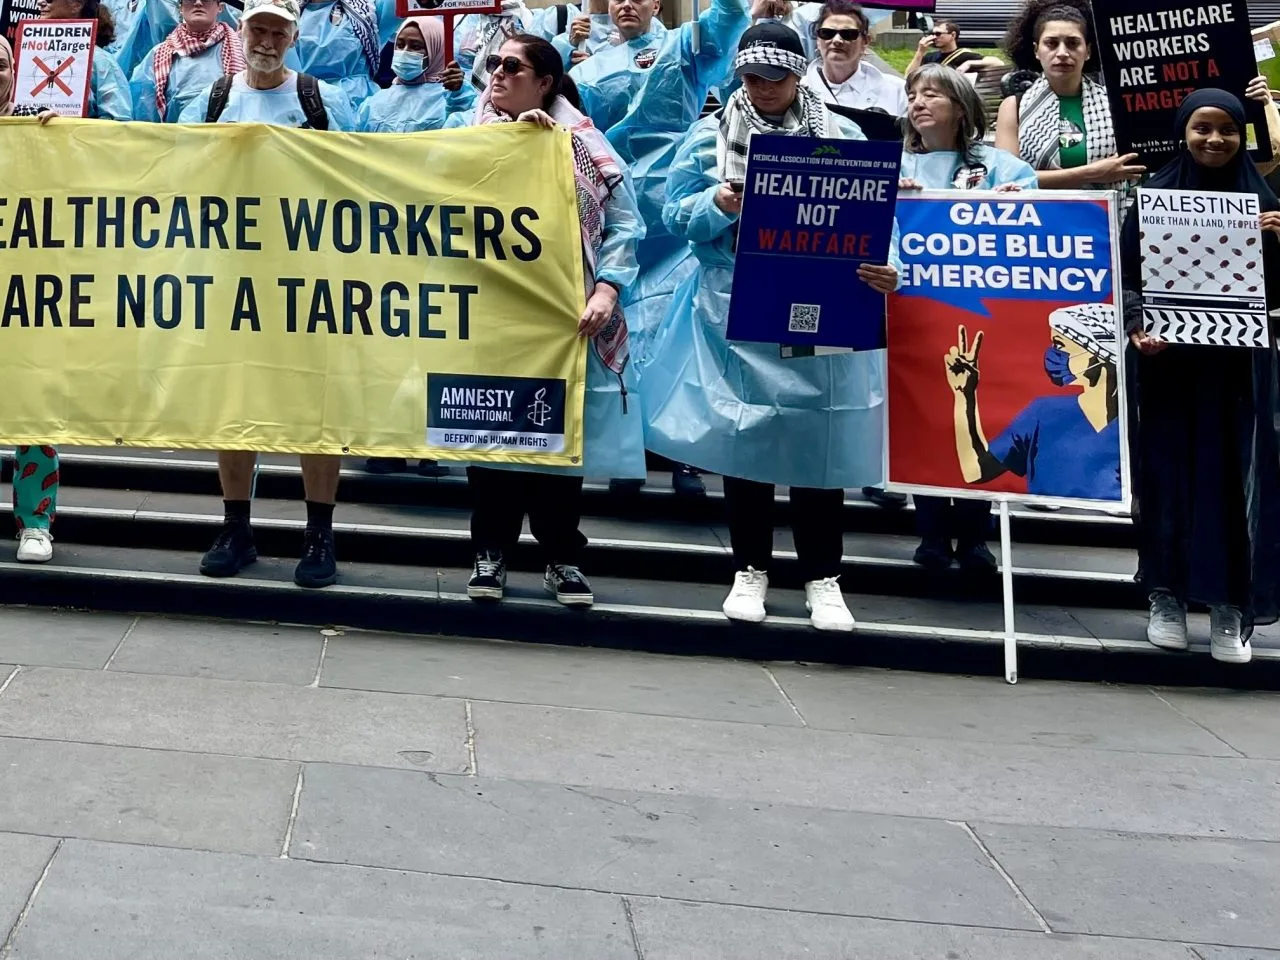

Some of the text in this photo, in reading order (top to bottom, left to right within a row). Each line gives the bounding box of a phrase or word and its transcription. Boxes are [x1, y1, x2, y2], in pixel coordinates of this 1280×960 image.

[23, 27, 91, 37] CHILDREN
[1109, 3, 1235, 36] HEALTHCARE
[22, 39, 90, 53] #NotATarget
[1113, 33, 1210, 61] WORKERS
[1120, 58, 1220, 87] ARE NOT A
[753, 154, 779, 162] MEDICAL
[780, 156, 820, 165] ASSOCIATION
[835, 159, 872, 168] PREVENTION
[754, 172, 890, 202] HEALTHCARE
[796, 204, 840, 226] NOT
[949, 202, 1042, 227] GAZA
[1140, 194, 1257, 216] PALESTINE
[280, 197, 542, 262] WORKERS
[1142, 216, 1225, 229] MORE THAN A LAND,
[758, 228, 872, 256] WARFARE
[901, 232, 1094, 260] CODE BLUE
[899, 265, 1108, 293] EMERGENCY
[1, 273, 479, 341] ARE NOT A TARGET
[440, 387, 515, 408] AMNESTY
[440, 408, 513, 422] INTERNATIONAL
[444, 433, 548, 447] DEFENDING HUMAN RIGHTS
